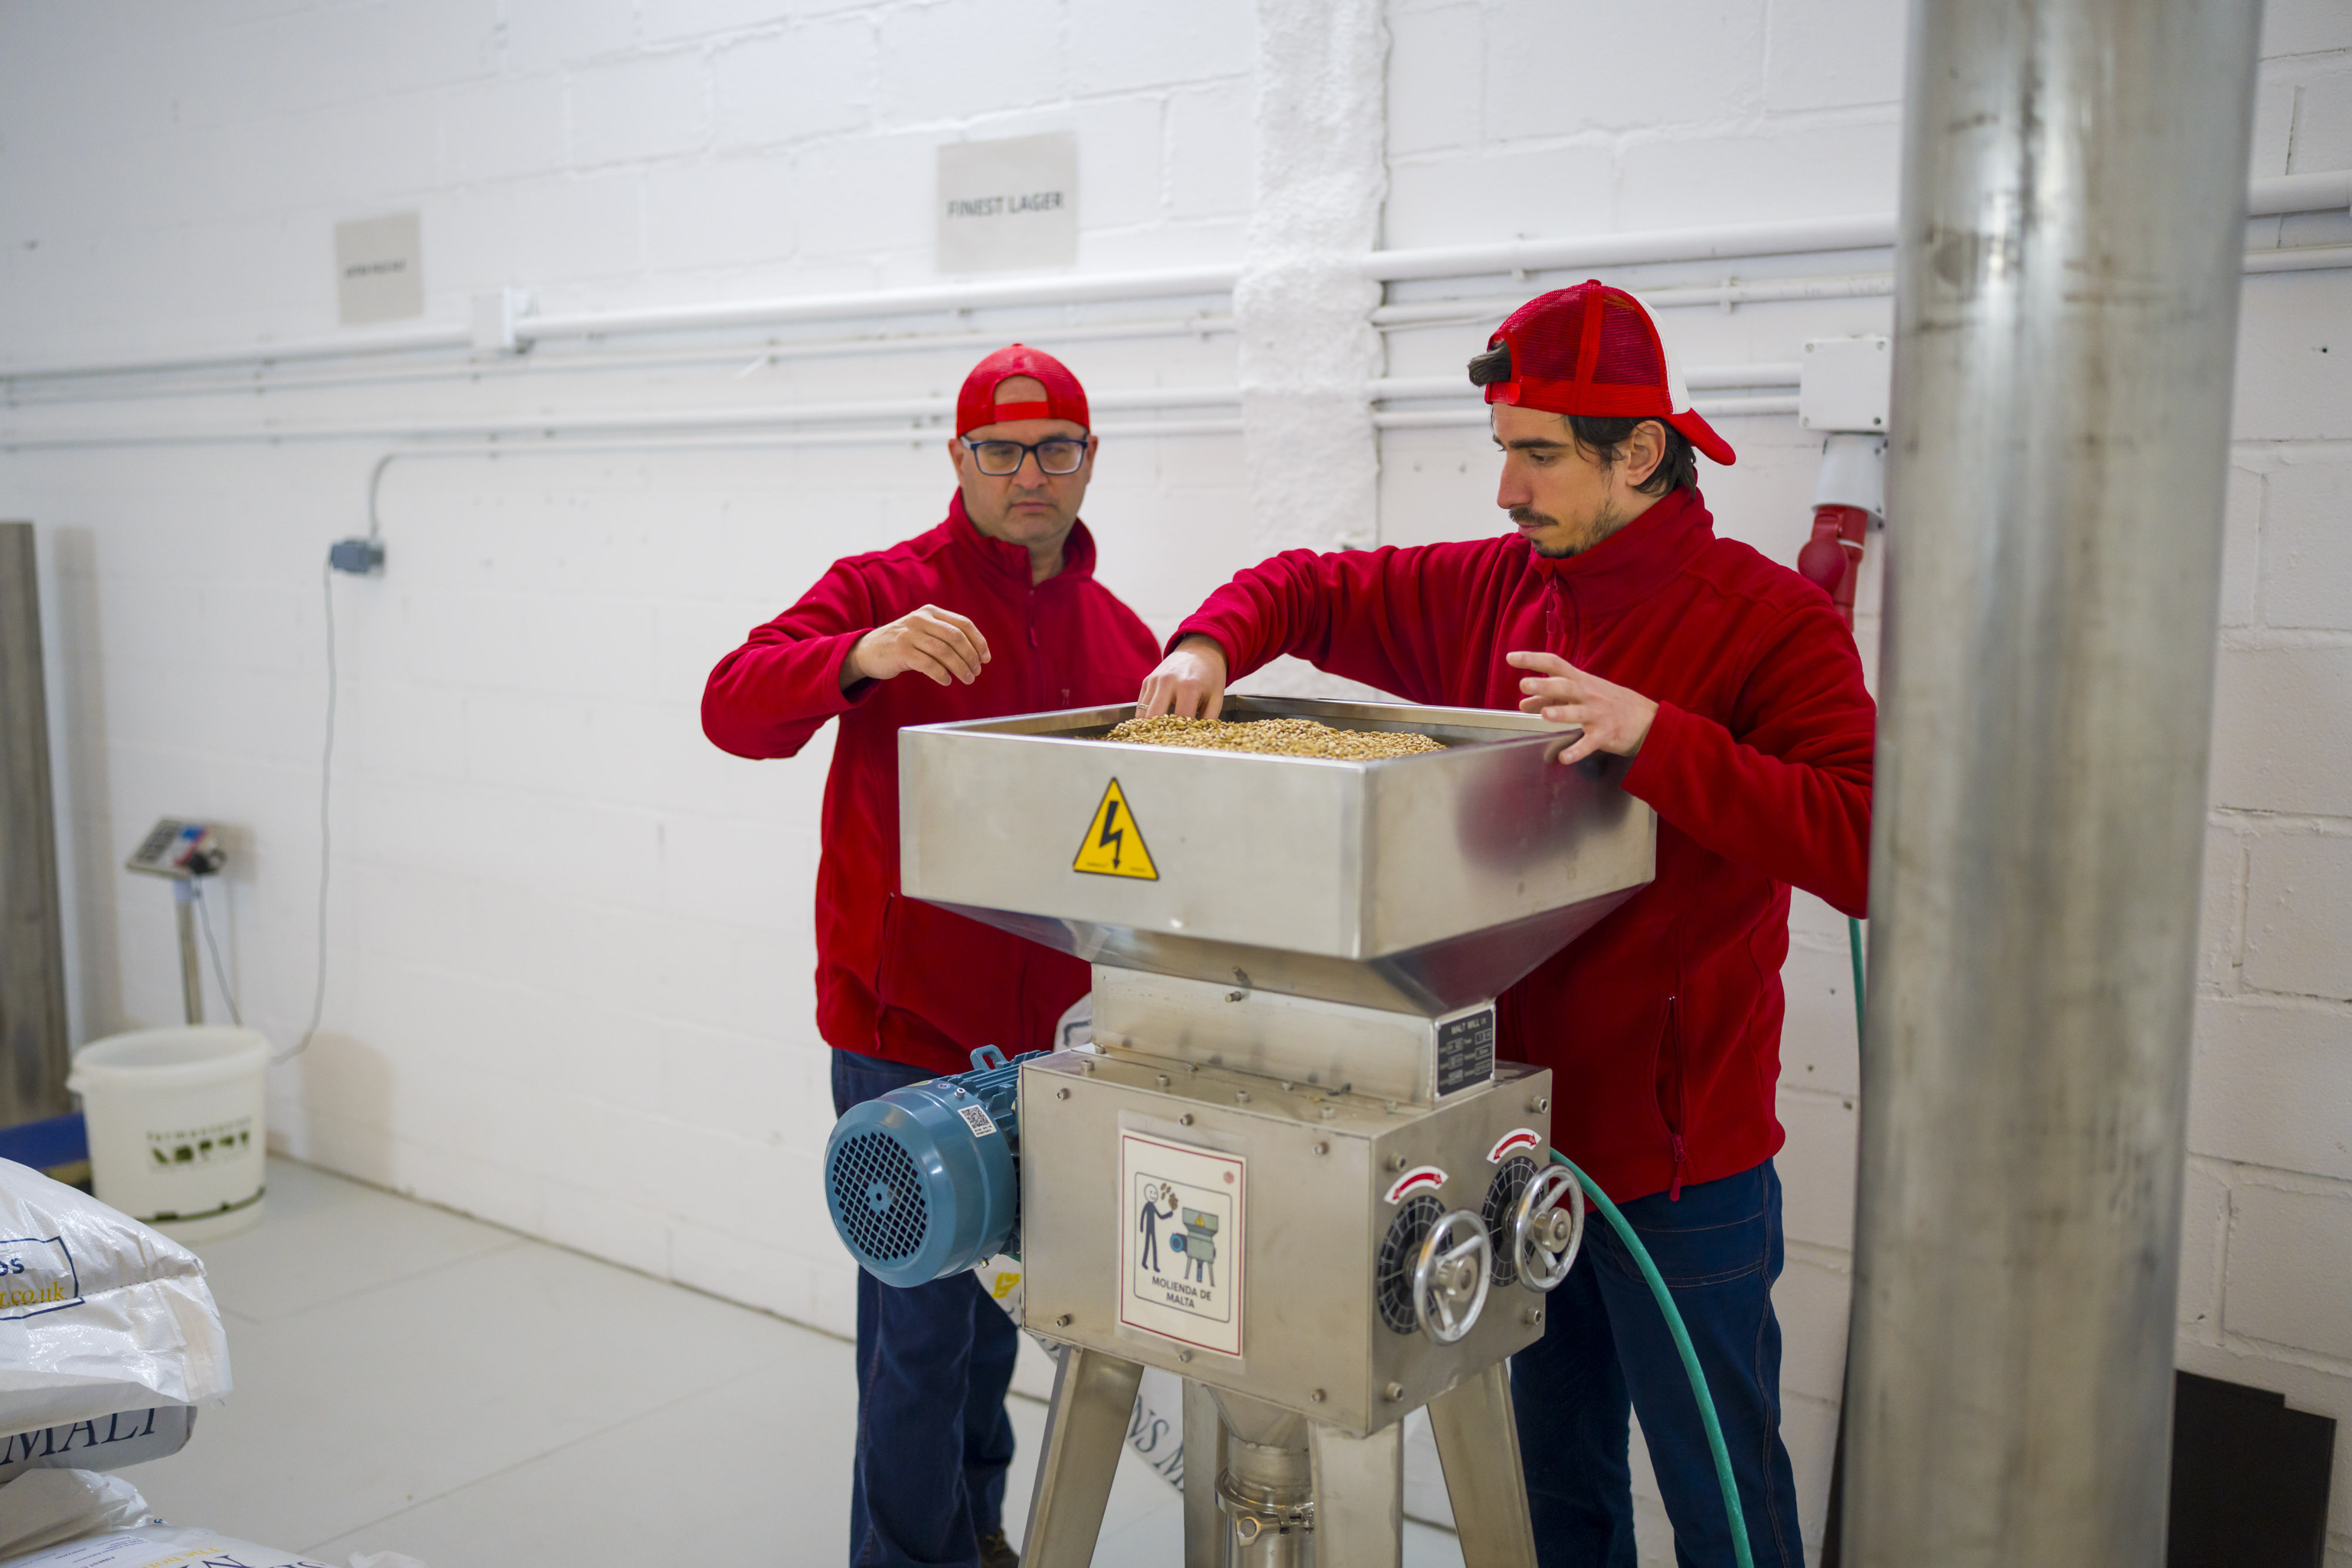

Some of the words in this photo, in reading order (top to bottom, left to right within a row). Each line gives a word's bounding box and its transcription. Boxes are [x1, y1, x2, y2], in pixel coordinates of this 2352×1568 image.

[948, 195, 1003, 217] FINEST
[1008, 191, 1063, 214] LAGER
[1152, 1276, 1197, 1297] MOLIENDA
[1200, 1289, 1212, 1302] DE
[1167, 1292, 1195, 1308] MALTA
